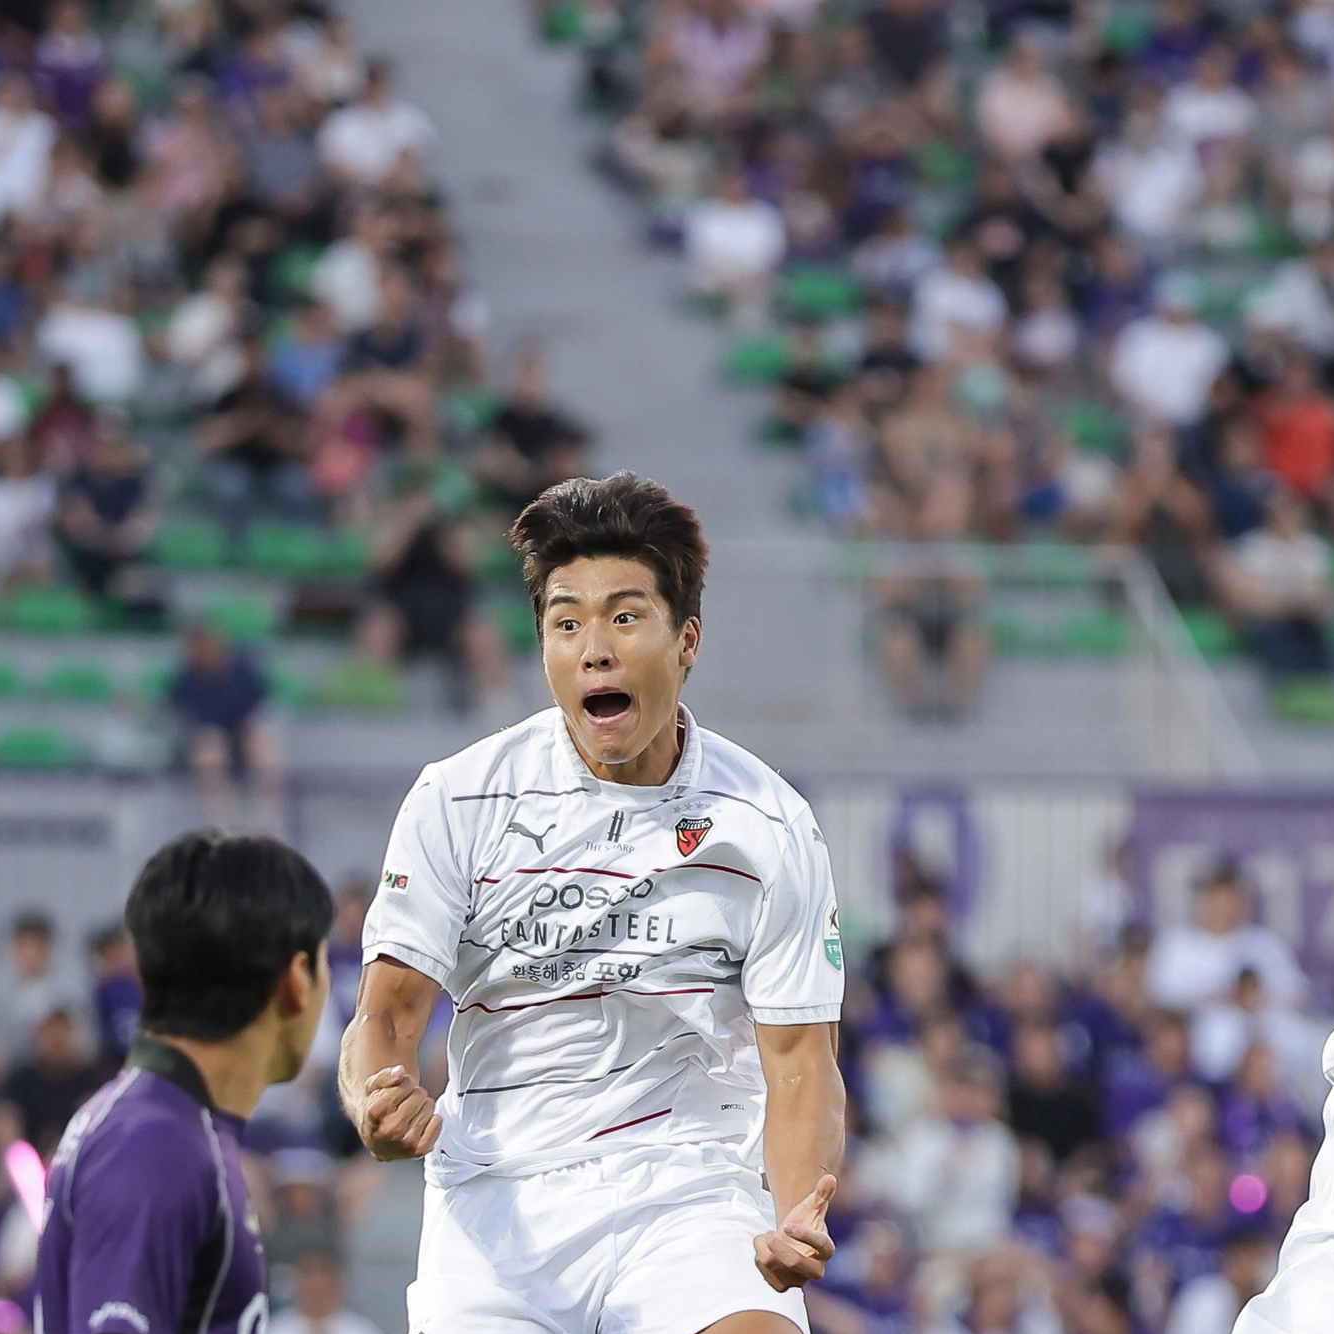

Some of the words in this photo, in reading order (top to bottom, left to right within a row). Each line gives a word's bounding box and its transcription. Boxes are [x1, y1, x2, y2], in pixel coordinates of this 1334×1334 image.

[585, 840, 602, 852] THE
[528, 878, 654, 916] posco
[501, 913, 677, 949] FANTASTEEL
[511, 962, 558, 982] 환동해
[561, 961, 587, 981] 중심
[592, 962, 643, 983] 포항
